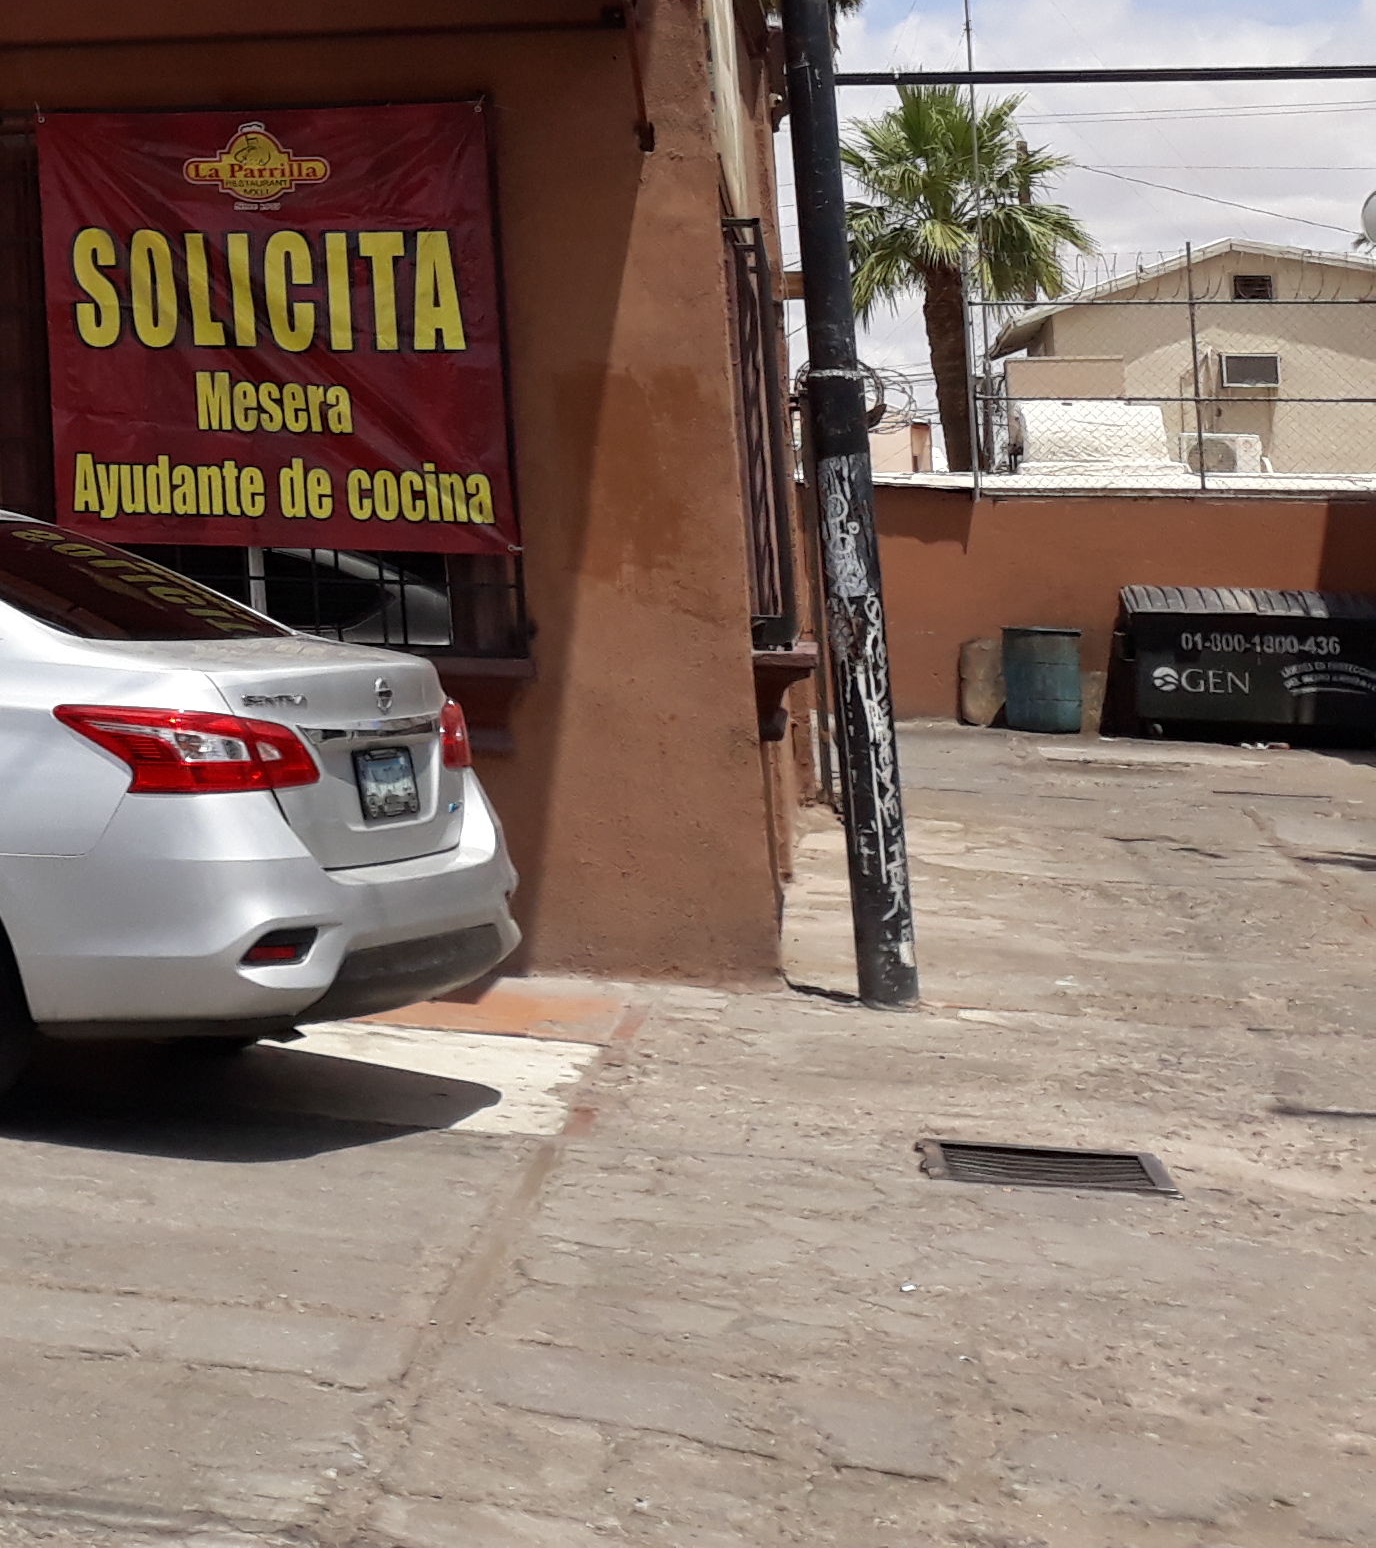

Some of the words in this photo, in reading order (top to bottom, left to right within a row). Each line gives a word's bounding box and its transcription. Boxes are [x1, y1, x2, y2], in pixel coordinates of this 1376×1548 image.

[194, 163, 220, 179] La
[228, 162, 318, 179] Parrilla
[73, 226, 466, 352] SOLICITA
[195, 370, 353, 434] Mesera
[74, 452, 266, 519] Ayudante
[279, 457, 333, 519] de
[348, 463, 495, 524] cocina
[1180, 669, 1250, 695] GEN
